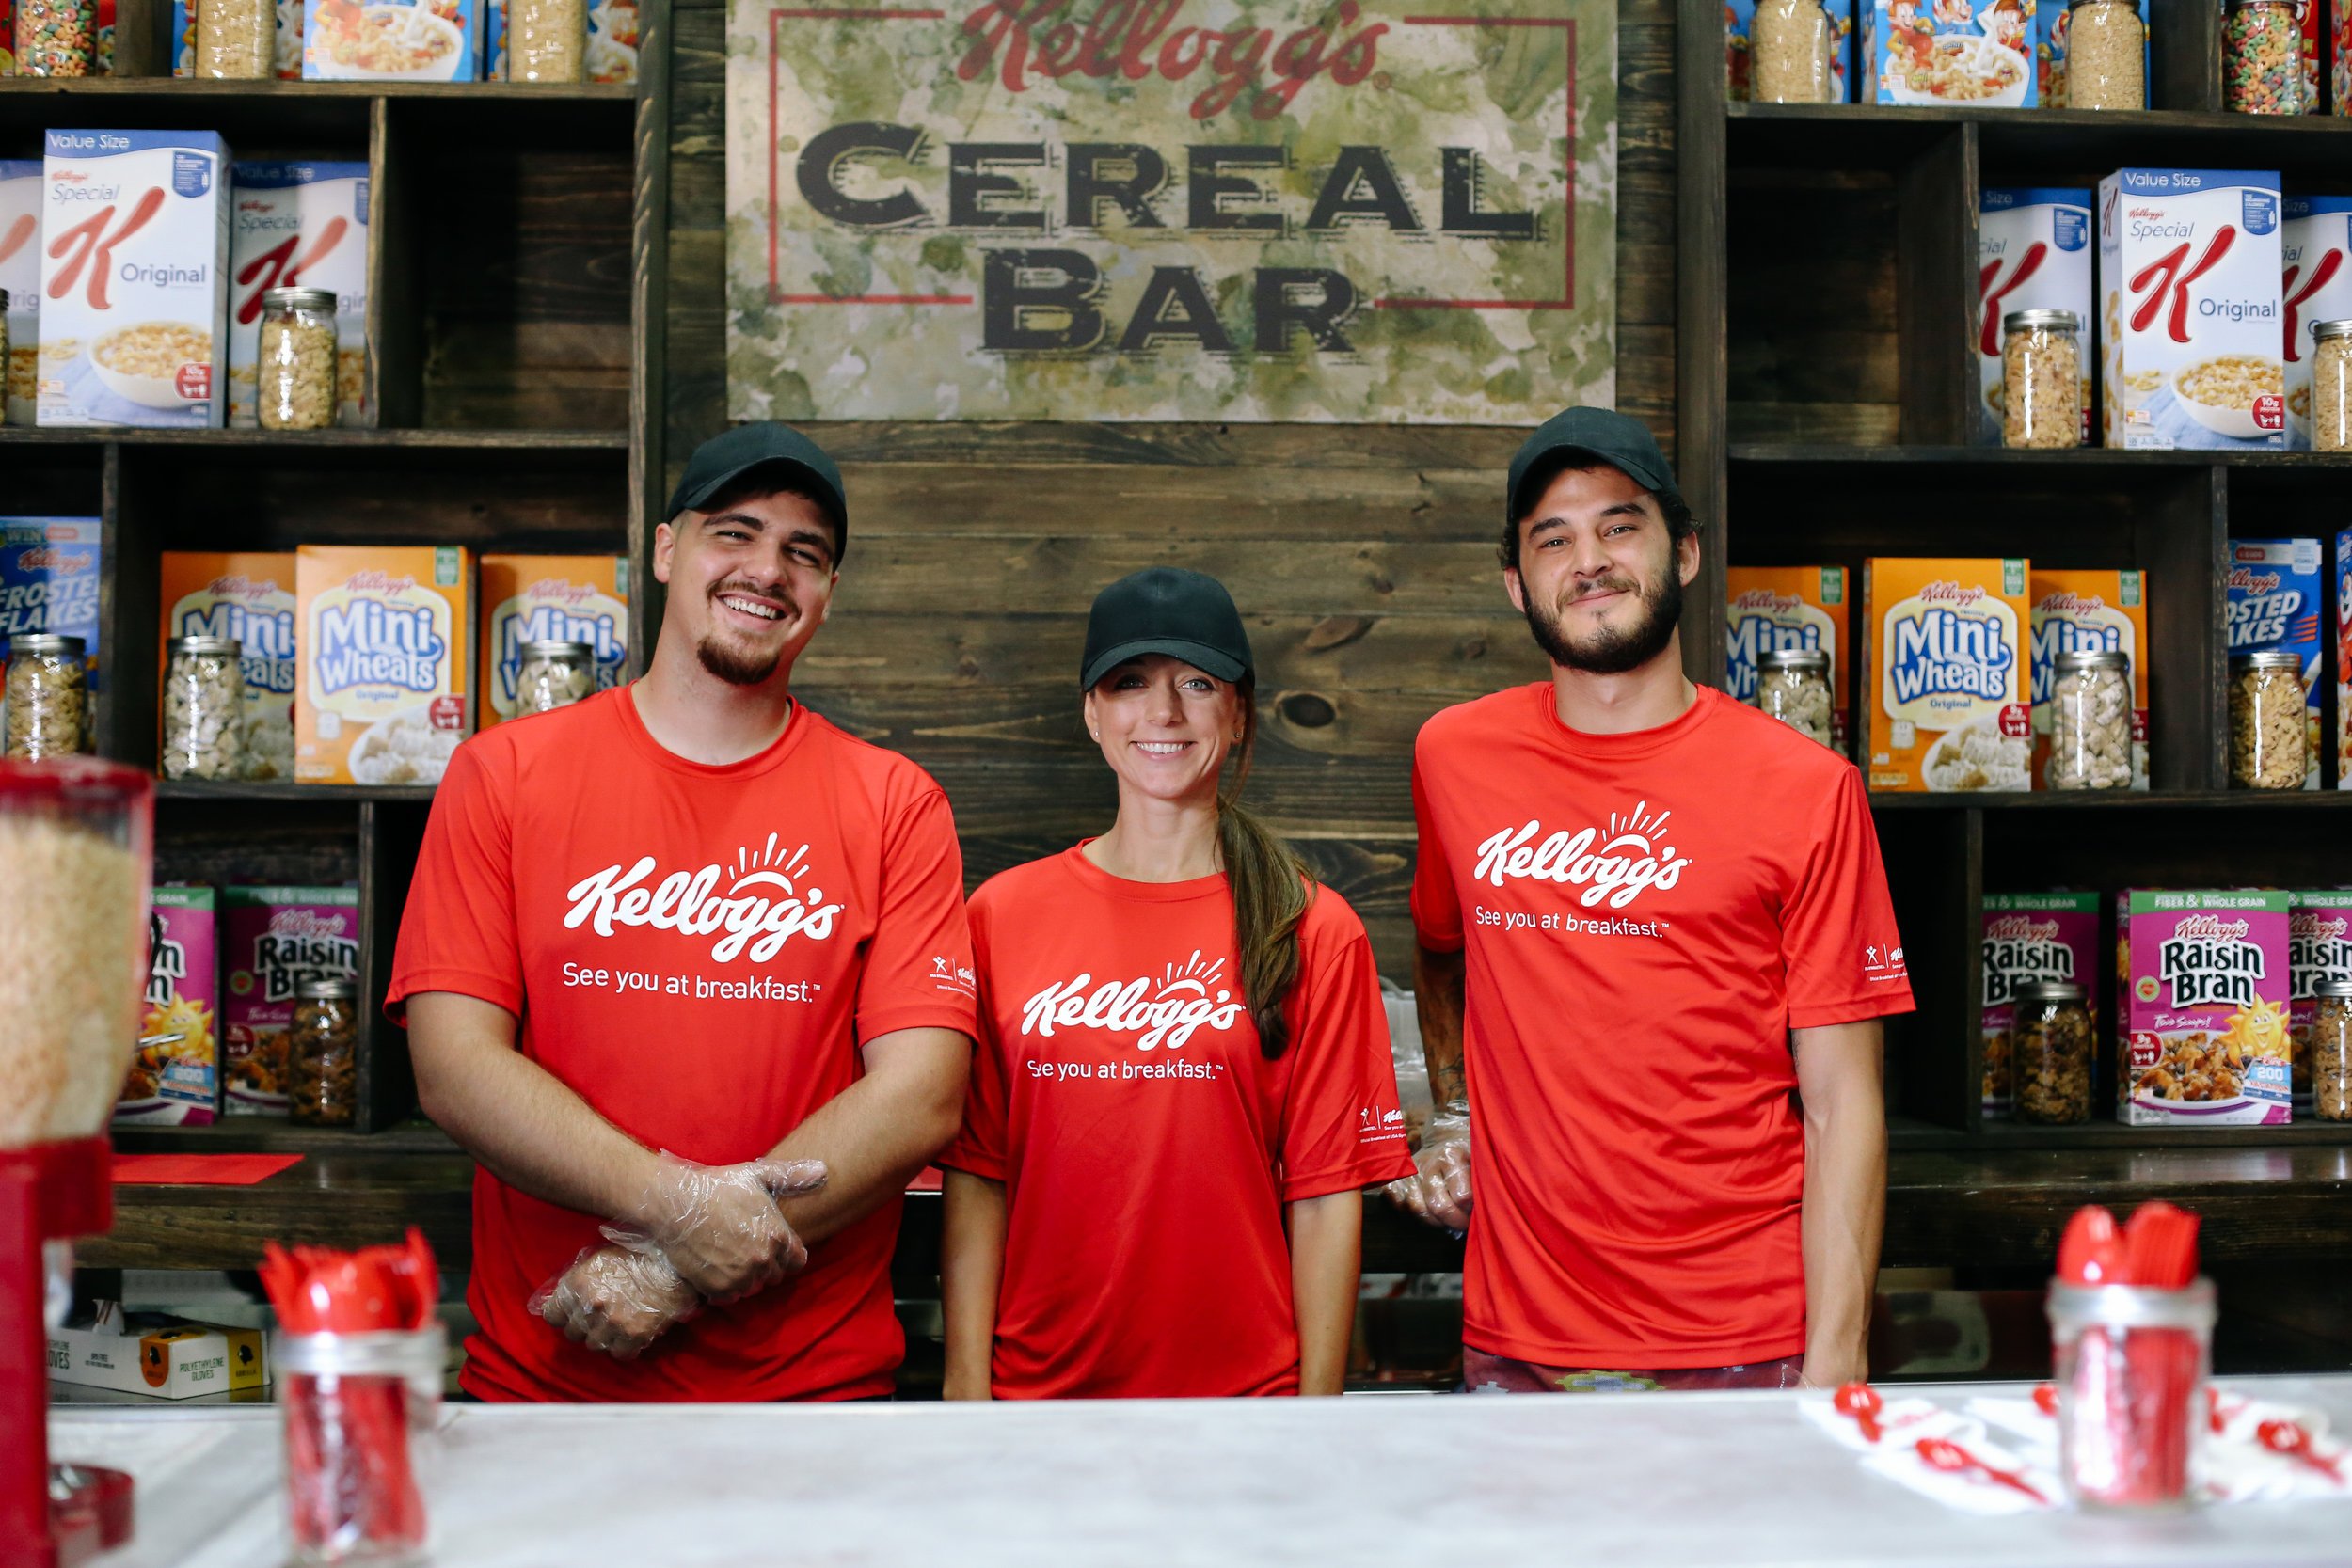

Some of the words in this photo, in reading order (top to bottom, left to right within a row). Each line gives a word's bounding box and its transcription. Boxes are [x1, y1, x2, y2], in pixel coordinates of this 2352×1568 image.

[957, 0, 1390, 119] Kellogg's
[50, 134, 95, 149] Value
[99, 134, 130, 149] Size
[52, 183, 120, 204] Special
[796, 122, 1543, 241] CEREAL
[2125, 173, 2169, 187] Value
[2172, 173, 2201, 187] Size
[239, 214, 307, 233] Special
[2130, 220, 2195, 243] Special
[48, 186, 165, 309] K
[121, 263, 205, 286] Original
[237, 216, 347, 324] K
[2129, 225, 2236, 342] K
[979, 248, 1364, 357] BAR
[2199, 298, 2276, 322] Original
[18, 547, 92, 576] Kellogg's
[209, 577, 278, 599] Kellogg's
[346, 569, 416, 596] Kellogg's
[530, 578, 598, 603] Kellogg's
[1921, 581, 1985, 607] Kellogg's
[1737, 591, 1801, 613] Kellogg's
[2041, 594, 2104, 616] Kellogg's
[184, 604, 293, 656] Mini
[323, 599, 434, 656] Mini
[504, 608, 613, 660] Mini
[1898, 610, 2002, 665] Mini
[319, 647, 437, 691] Wheats
[1895, 656, 2006, 703] Wheats
[356, 689, 400, 705] Original
[1931, 699, 1972, 713] Original
[1474, 819, 1689, 909] Kellogg's
[564, 855, 841, 963] Kellogg's
[2154, 895, 2185, 908] FIBER
[2186, 894, 2200, 909] &
[2202, 895, 2237, 908] WHOLE
[2238, 897, 2266, 908] GRAIN
[269, 909, 347, 938] Kellogg's
[1475, 906, 1501, 926] See
[1505, 912, 1536, 931] you
[1541, 912, 1560, 929] at
[1989, 916, 2059, 942] Kellogg's
[2176, 914, 2249, 942] Kellogg's
[2290, 914, 2347, 942] ellogg's
[256, 937, 358, 971] Raisin
[2165, 942, 2265, 975] Raisin
[563, 962, 609, 986] See
[615, 970, 659, 994] you
[665, 974, 690, 997] at
[2176, 974, 2252, 1004] Bran
[1021, 973, 1243, 1052] Kellogg's
[1057, 1062, 1092, 1082] you
[1097, 1061, 1117, 1080] at
[2257, 1067, 2284, 1082] 200
[179, 1356, 225, 1373] POLYETHYLENE
[191, 1369, 215, 1382] GLOVES
